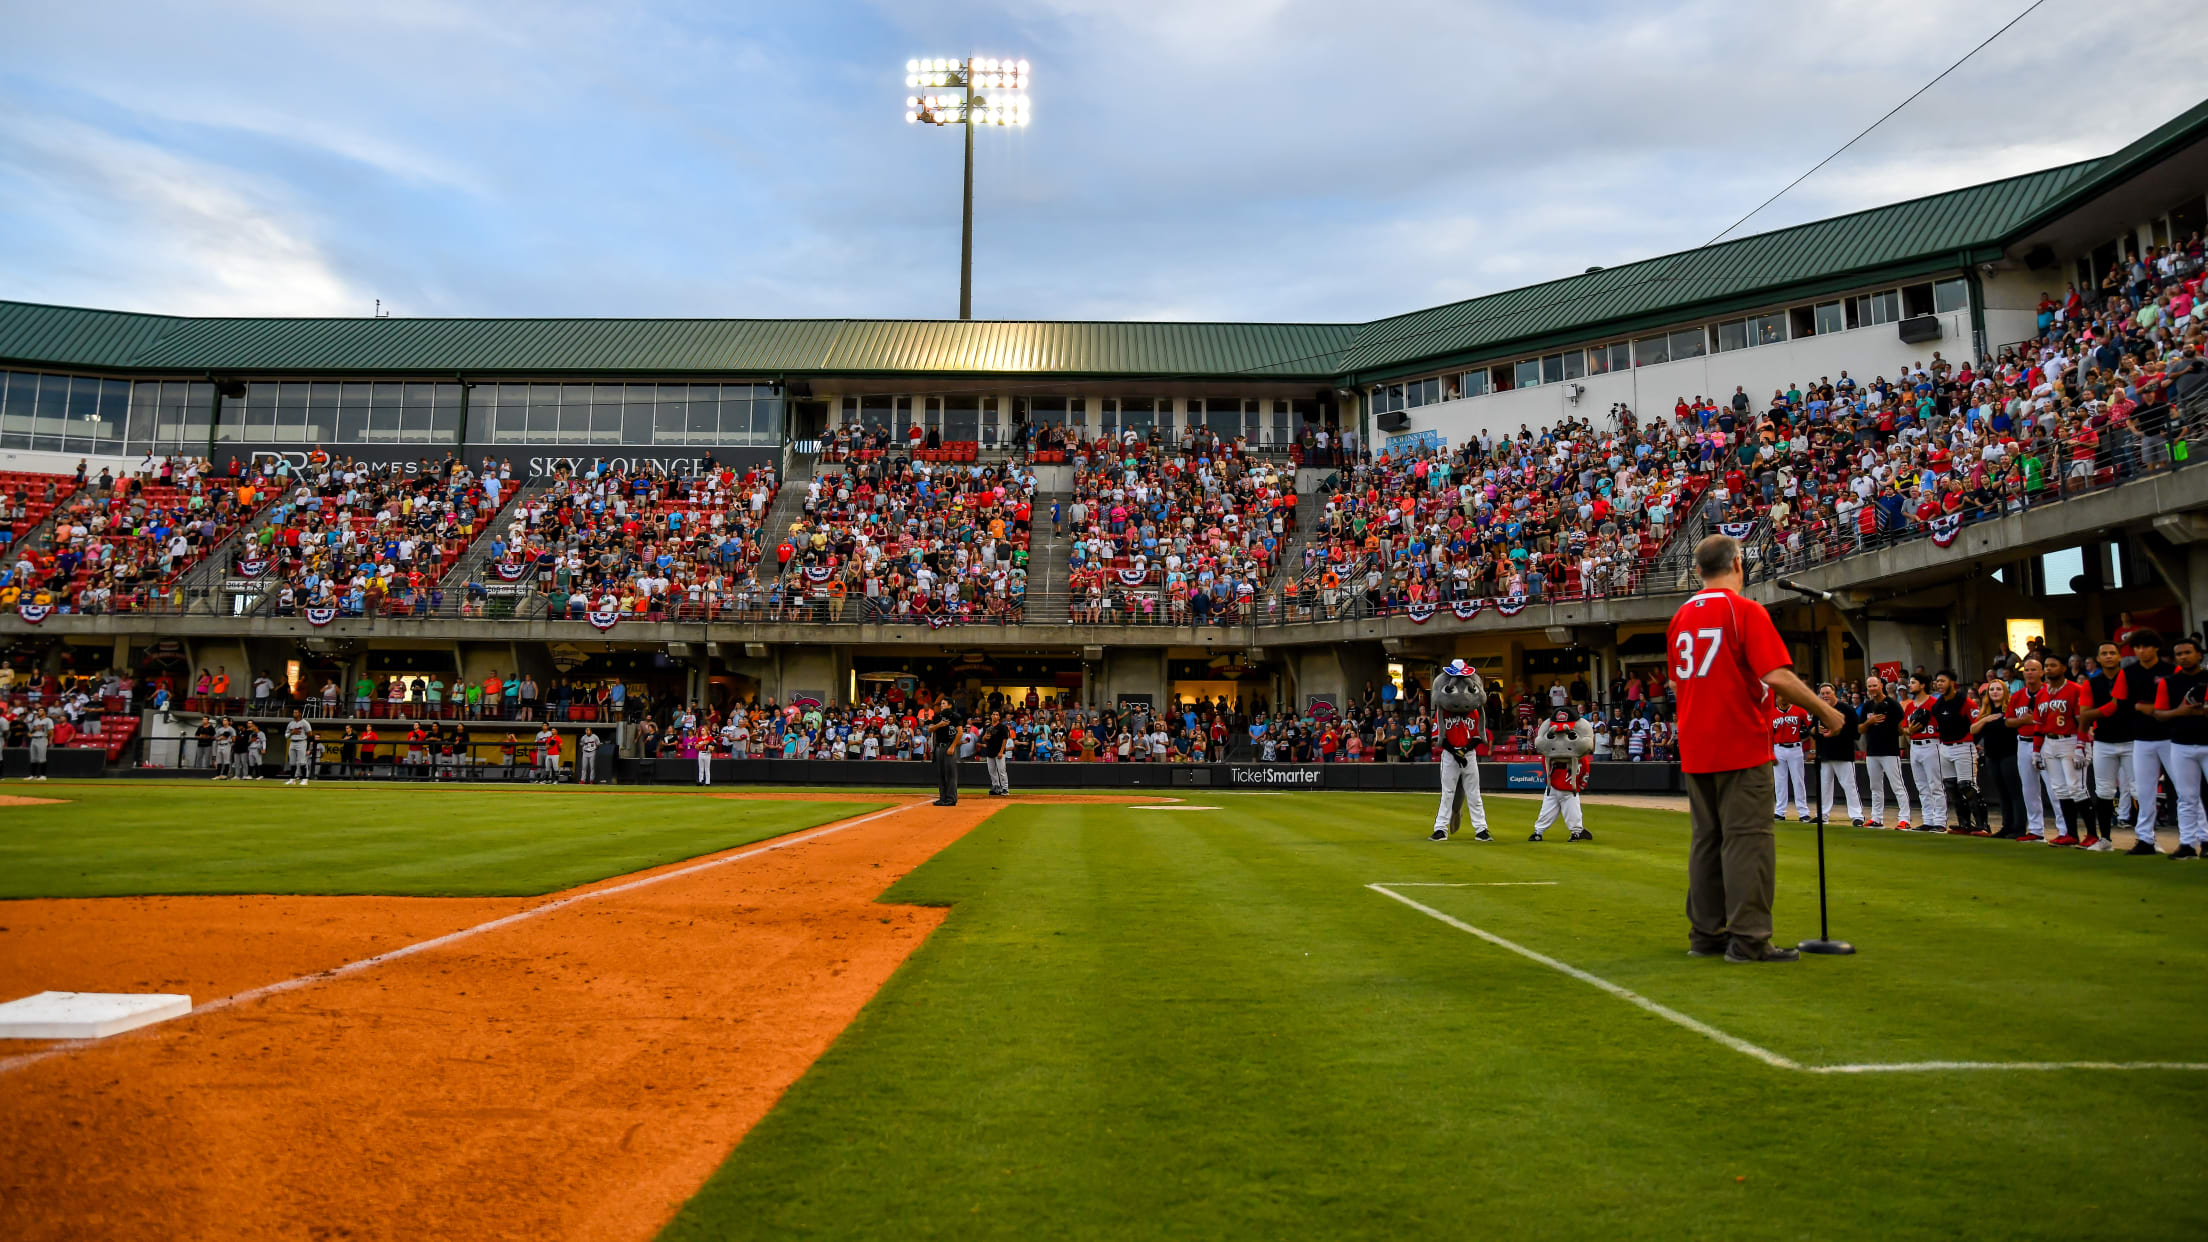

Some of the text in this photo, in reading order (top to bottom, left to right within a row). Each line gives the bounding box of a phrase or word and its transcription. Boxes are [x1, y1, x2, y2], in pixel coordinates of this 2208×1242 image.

[355, 461, 418, 474] OMES
[529, 457, 585, 478] SKY
[1675, 627, 1723, 679] 37
[2056, 716, 2065, 727] 6
[1792, 727, 1797, 735] 7
[1231, 767, 1320, 783] TicketSmarter
